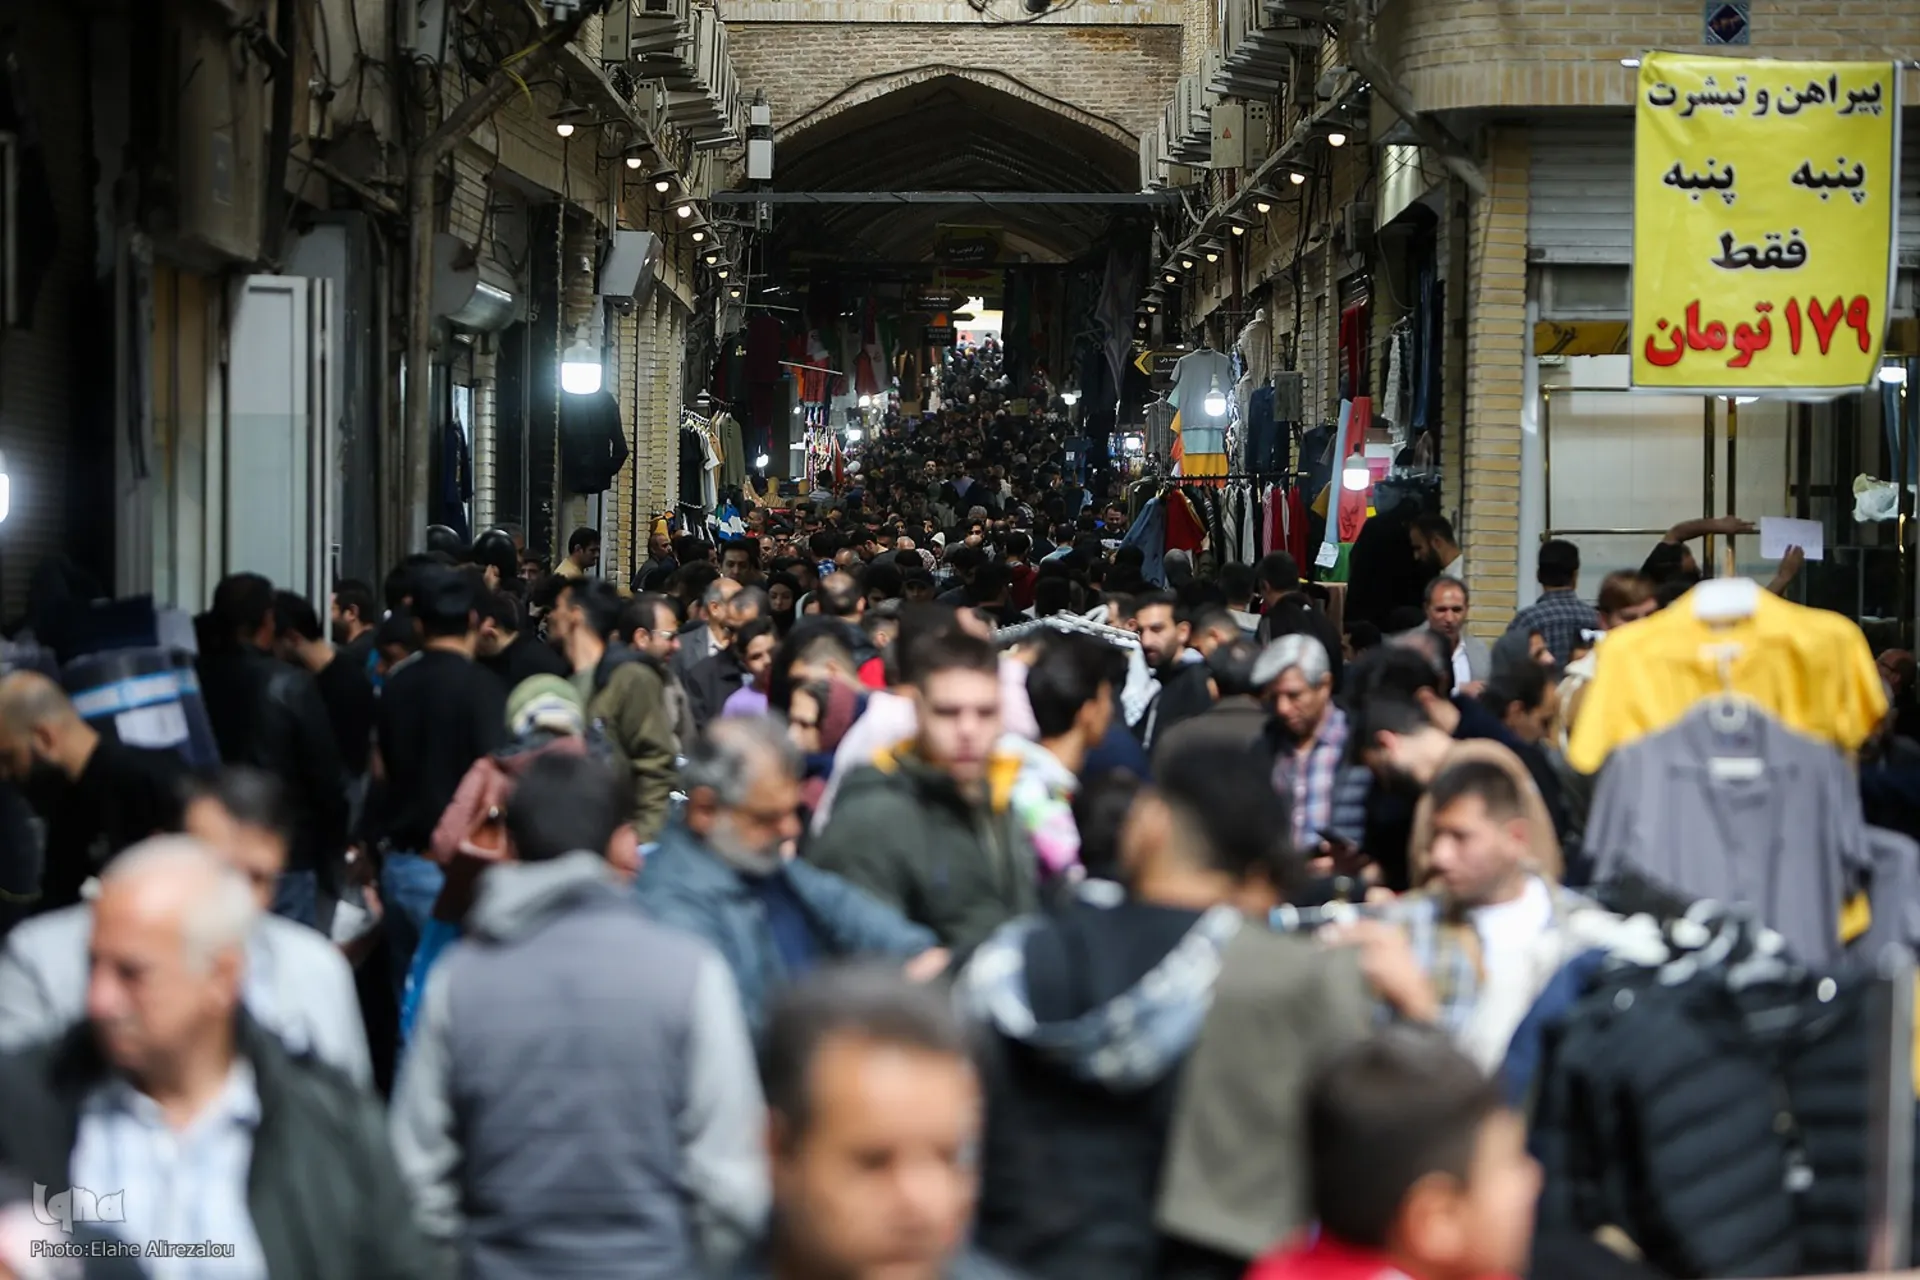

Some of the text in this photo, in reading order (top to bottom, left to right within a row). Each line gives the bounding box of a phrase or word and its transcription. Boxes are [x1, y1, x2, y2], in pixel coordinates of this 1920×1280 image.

[1647, 73, 1883, 118] پیراهن و تیشرت
[1663, 157, 1866, 205] پنبه پنبه
[1711, 228, 1808, 270] فقط
[1645, 295, 1871, 368] ۱۷۹ تومان
